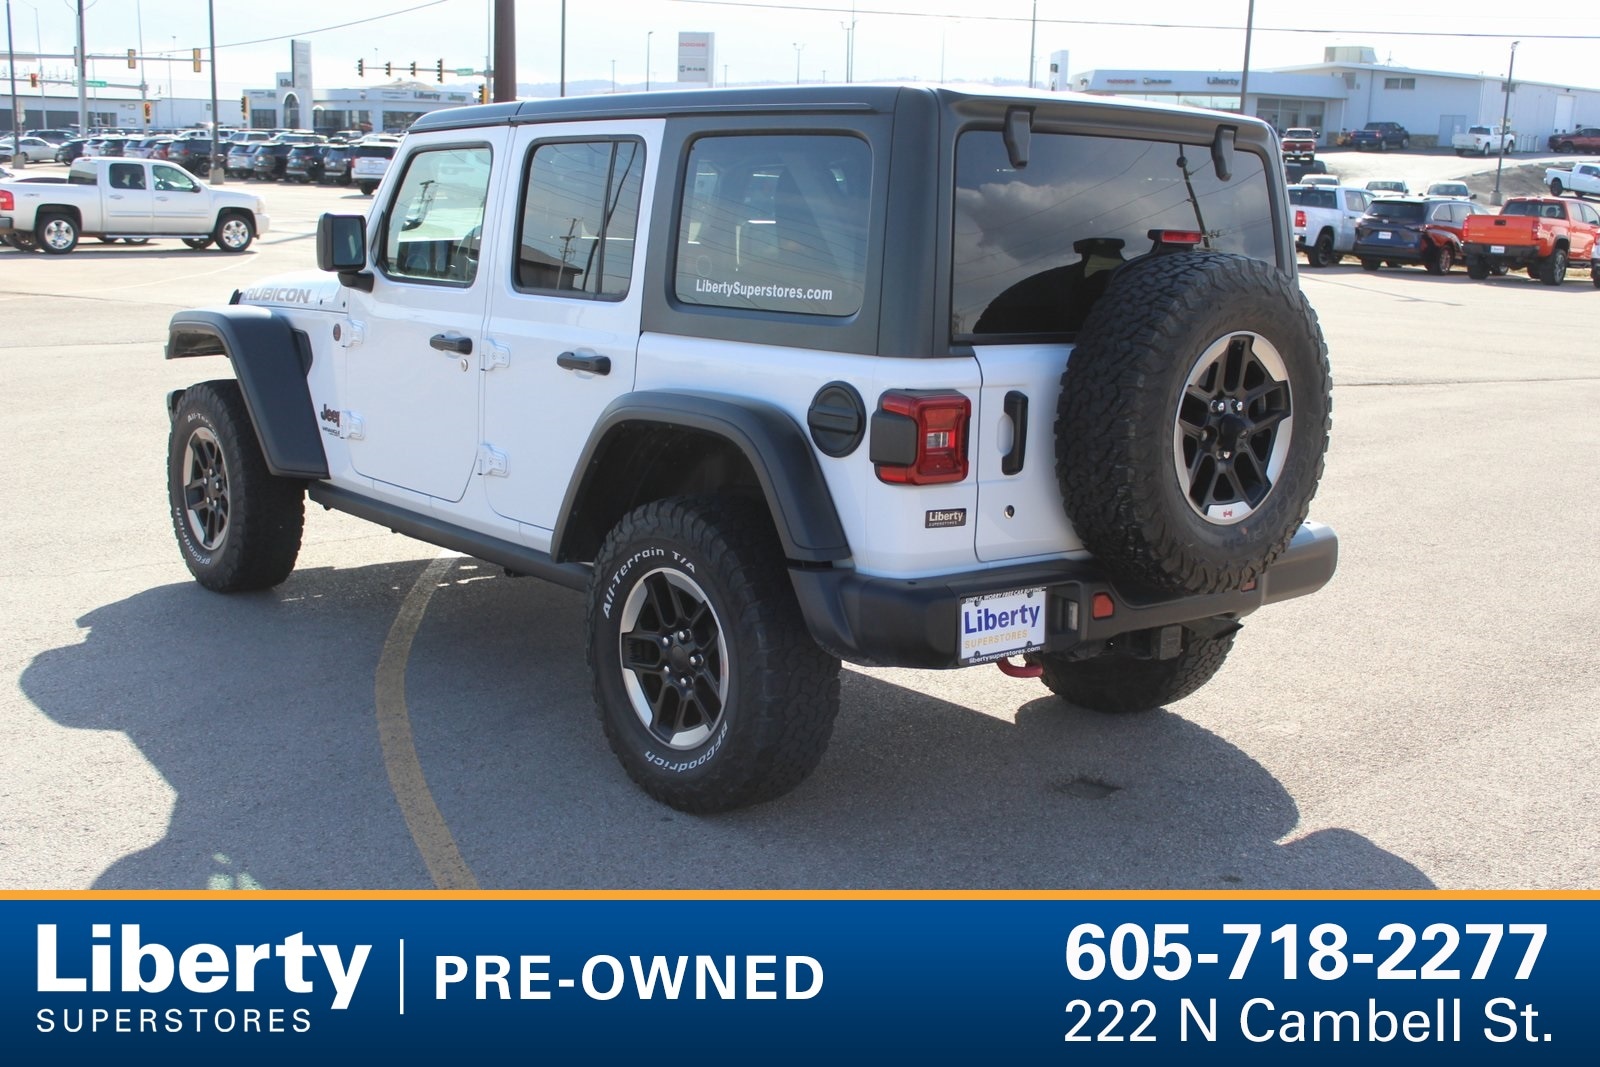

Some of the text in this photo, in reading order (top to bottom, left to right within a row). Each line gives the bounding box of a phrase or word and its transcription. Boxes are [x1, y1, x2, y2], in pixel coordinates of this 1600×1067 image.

[1206, 76, 1240, 86] Liberty
[243, 287, 312, 304] RUBICON
[696, 279, 833, 301] LibertySuperstores.com
[929, 511, 964, 522] Liberty
[603, 546, 696, 619] All-Terrain T/A
[964, 604, 1041, 634] Liberty
[964, 629, 1029, 649] SUPERSTORES
[968, 645, 1041, 664] libertysuperstores.com
[644, 719, 728, 773] BFGoodrich
